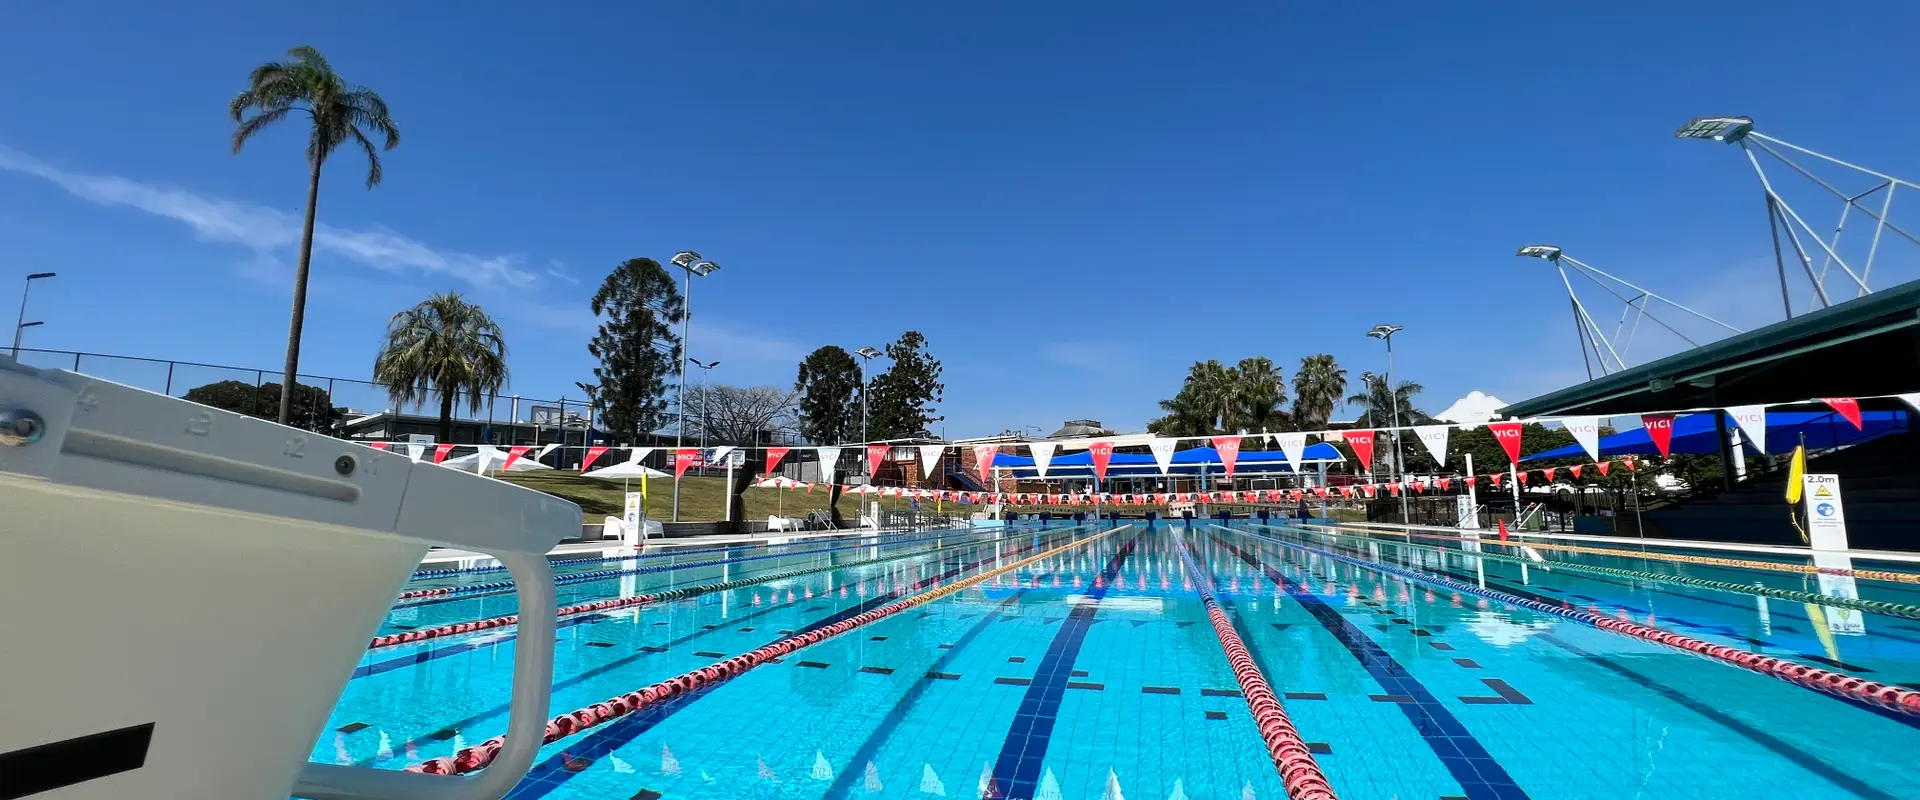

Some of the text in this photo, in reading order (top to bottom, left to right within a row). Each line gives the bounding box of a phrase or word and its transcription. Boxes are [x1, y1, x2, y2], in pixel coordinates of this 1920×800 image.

[1737, 414, 1763, 422] VICI
[1645, 419, 1671, 429] VICI
[1494, 429, 1519, 437] VICI
[1570, 425, 1596, 433] VICI
[1348, 436, 1371, 444] VICI
[1421, 432, 1445, 441] VICI
[1808, 475, 1835, 484] 2.0m
